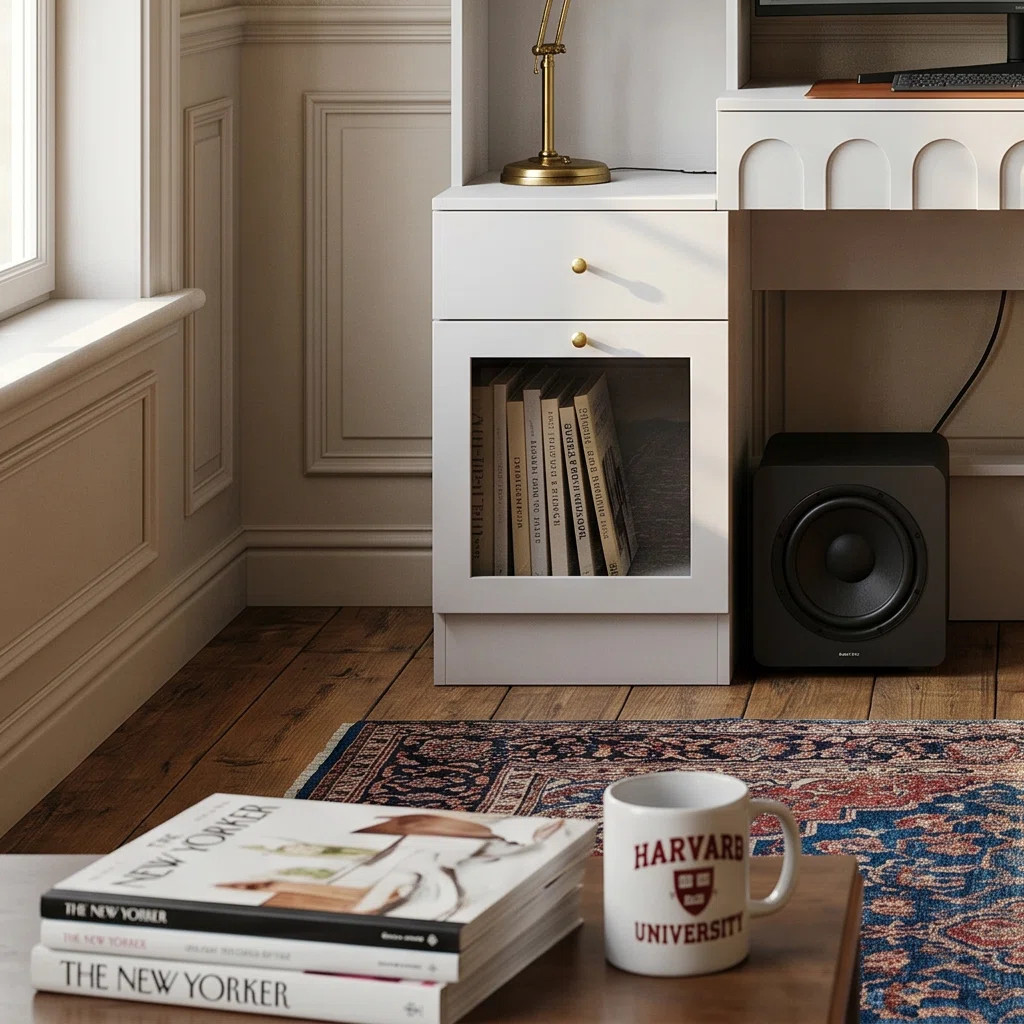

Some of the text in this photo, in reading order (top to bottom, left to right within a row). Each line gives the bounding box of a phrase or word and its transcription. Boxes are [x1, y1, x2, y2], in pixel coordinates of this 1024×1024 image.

[111, 804, 282, 888] NEW YORKER
[64, 902, 88, 916] THE
[90, 904, 119, 918] NEW
[60, 960, 290, 1009] THE NEW YORKER
